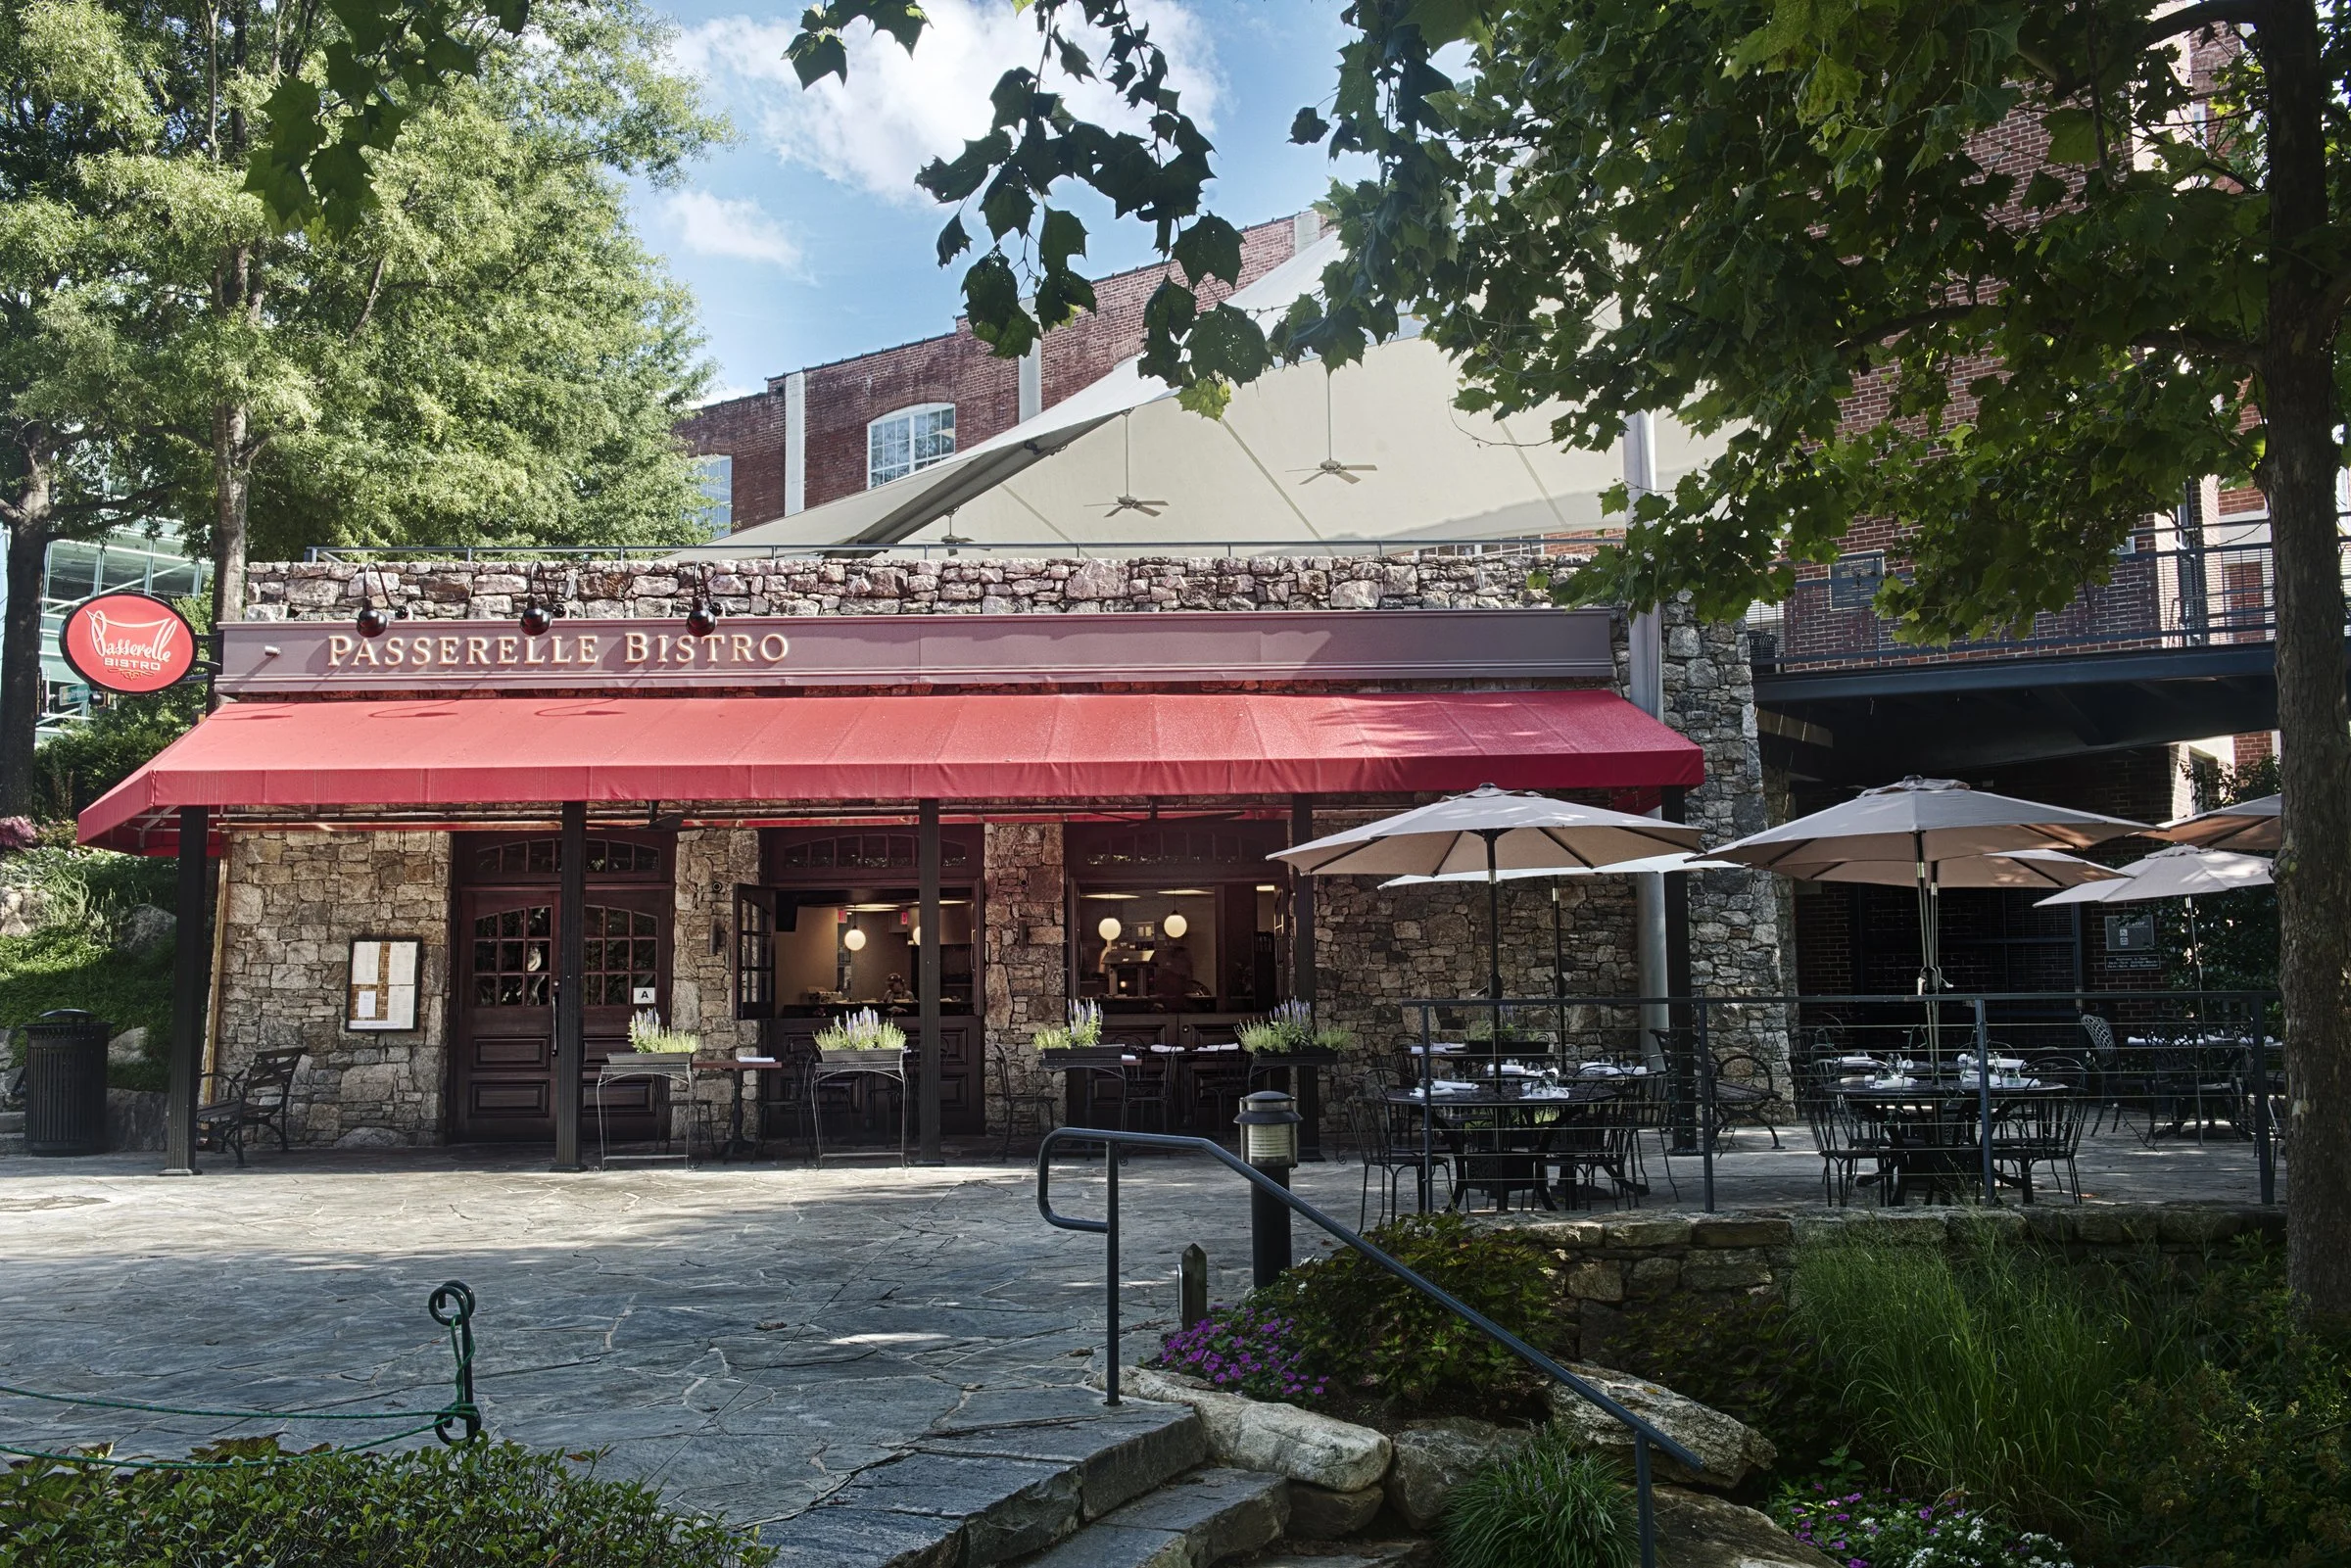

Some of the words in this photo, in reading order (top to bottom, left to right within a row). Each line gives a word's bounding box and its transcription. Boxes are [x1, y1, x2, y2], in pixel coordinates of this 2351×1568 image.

[85, 609, 178, 663] Passerelle
[327, 635, 600, 666] PASSERELLE
[624, 633, 789, 663] BISTRO
[104, 657, 162, 671] BISTRO
[641, 990, 649, 999] A
